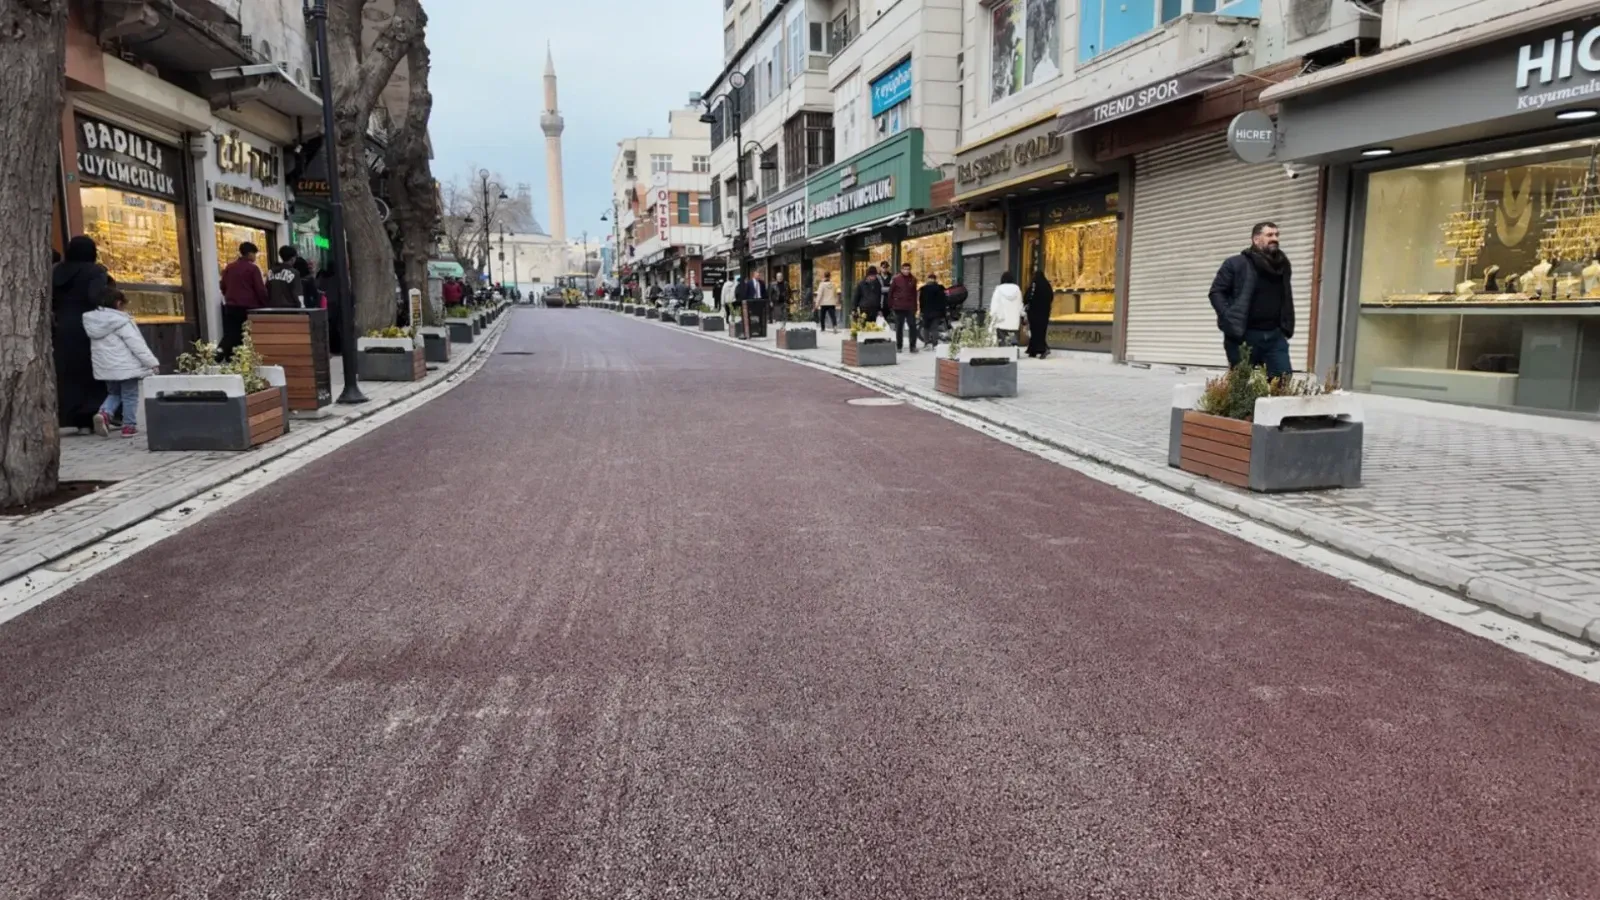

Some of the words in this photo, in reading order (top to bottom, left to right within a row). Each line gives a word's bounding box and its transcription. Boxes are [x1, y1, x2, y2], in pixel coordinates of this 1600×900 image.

[1093, 95, 1135, 121] TREND
[1138, 79, 1179, 107] SPOR
[657, 189, 668, 242] OTEL
